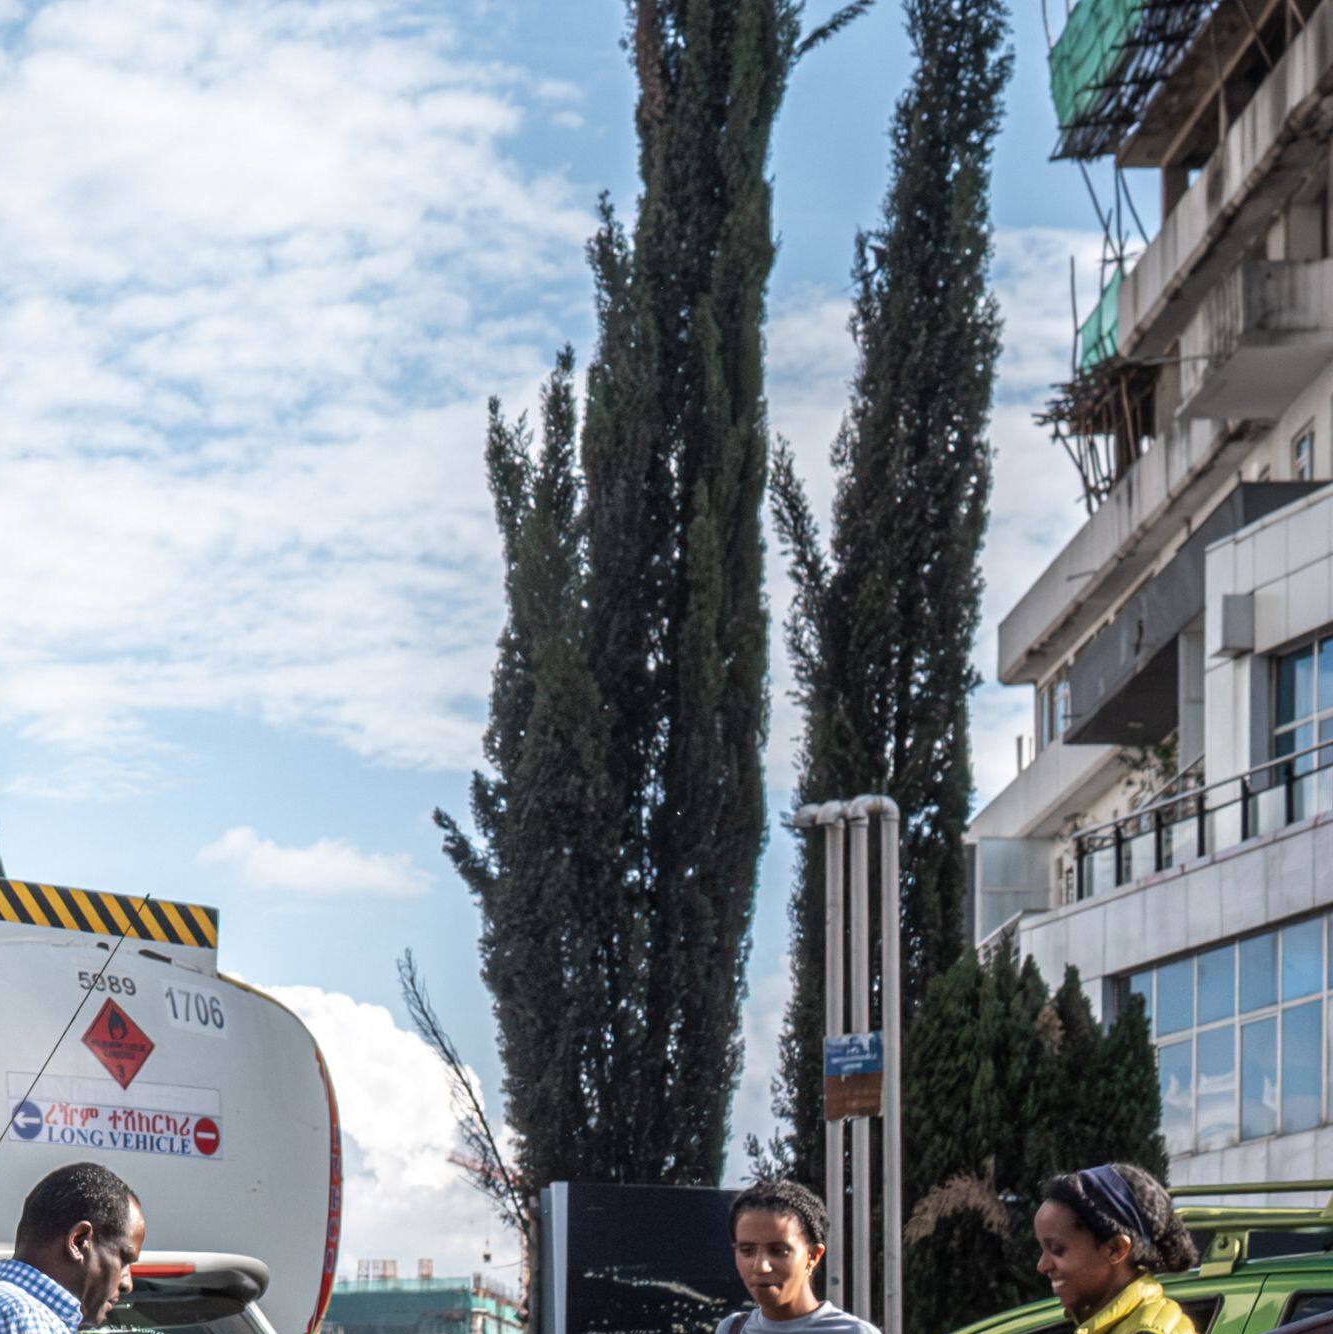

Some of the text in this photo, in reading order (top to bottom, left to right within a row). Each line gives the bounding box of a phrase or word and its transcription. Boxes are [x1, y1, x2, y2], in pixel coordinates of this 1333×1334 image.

[78, 970, 137, 996] 5989
[165, 986, 224, 1030] 1706
[48, 1126, 191, 1155] LONG VEHICLE
